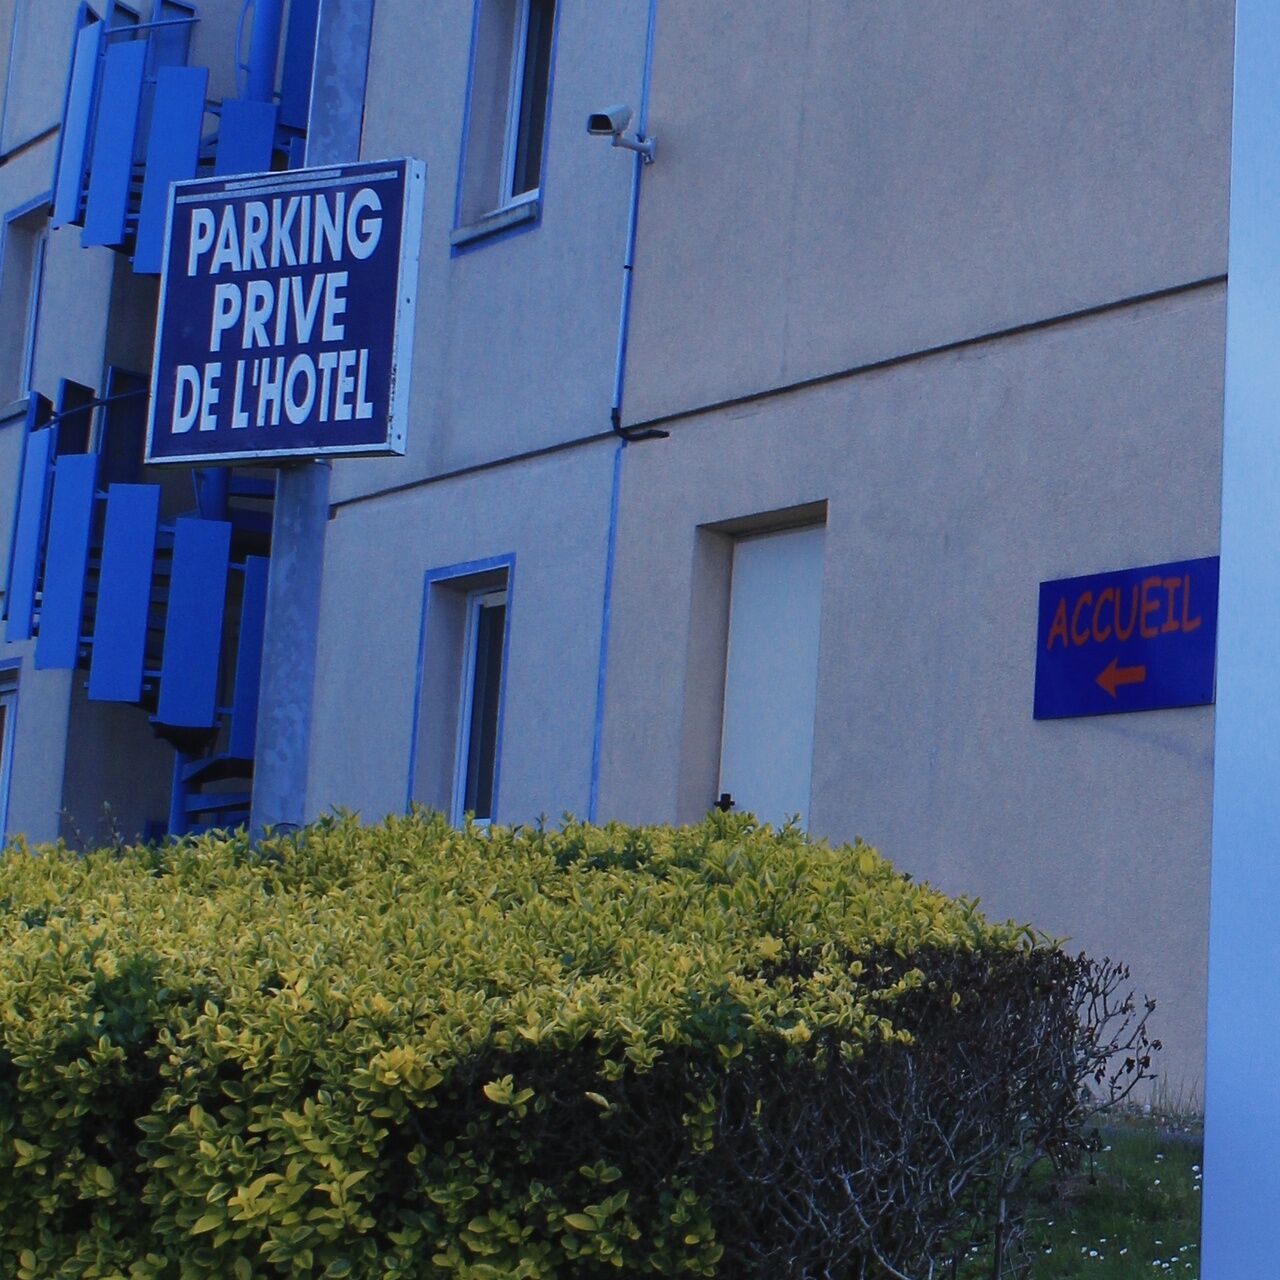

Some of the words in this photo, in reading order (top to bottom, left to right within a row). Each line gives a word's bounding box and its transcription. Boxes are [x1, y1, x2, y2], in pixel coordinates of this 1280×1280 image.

[187, 188, 383, 276] PARKING
[210, 271, 349, 352] PRIVE
[171, 362, 222, 434] DE
[231, 348, 373, 429] L'HOTEL
[1046, 575, 1201, 650] ACCUEIL
